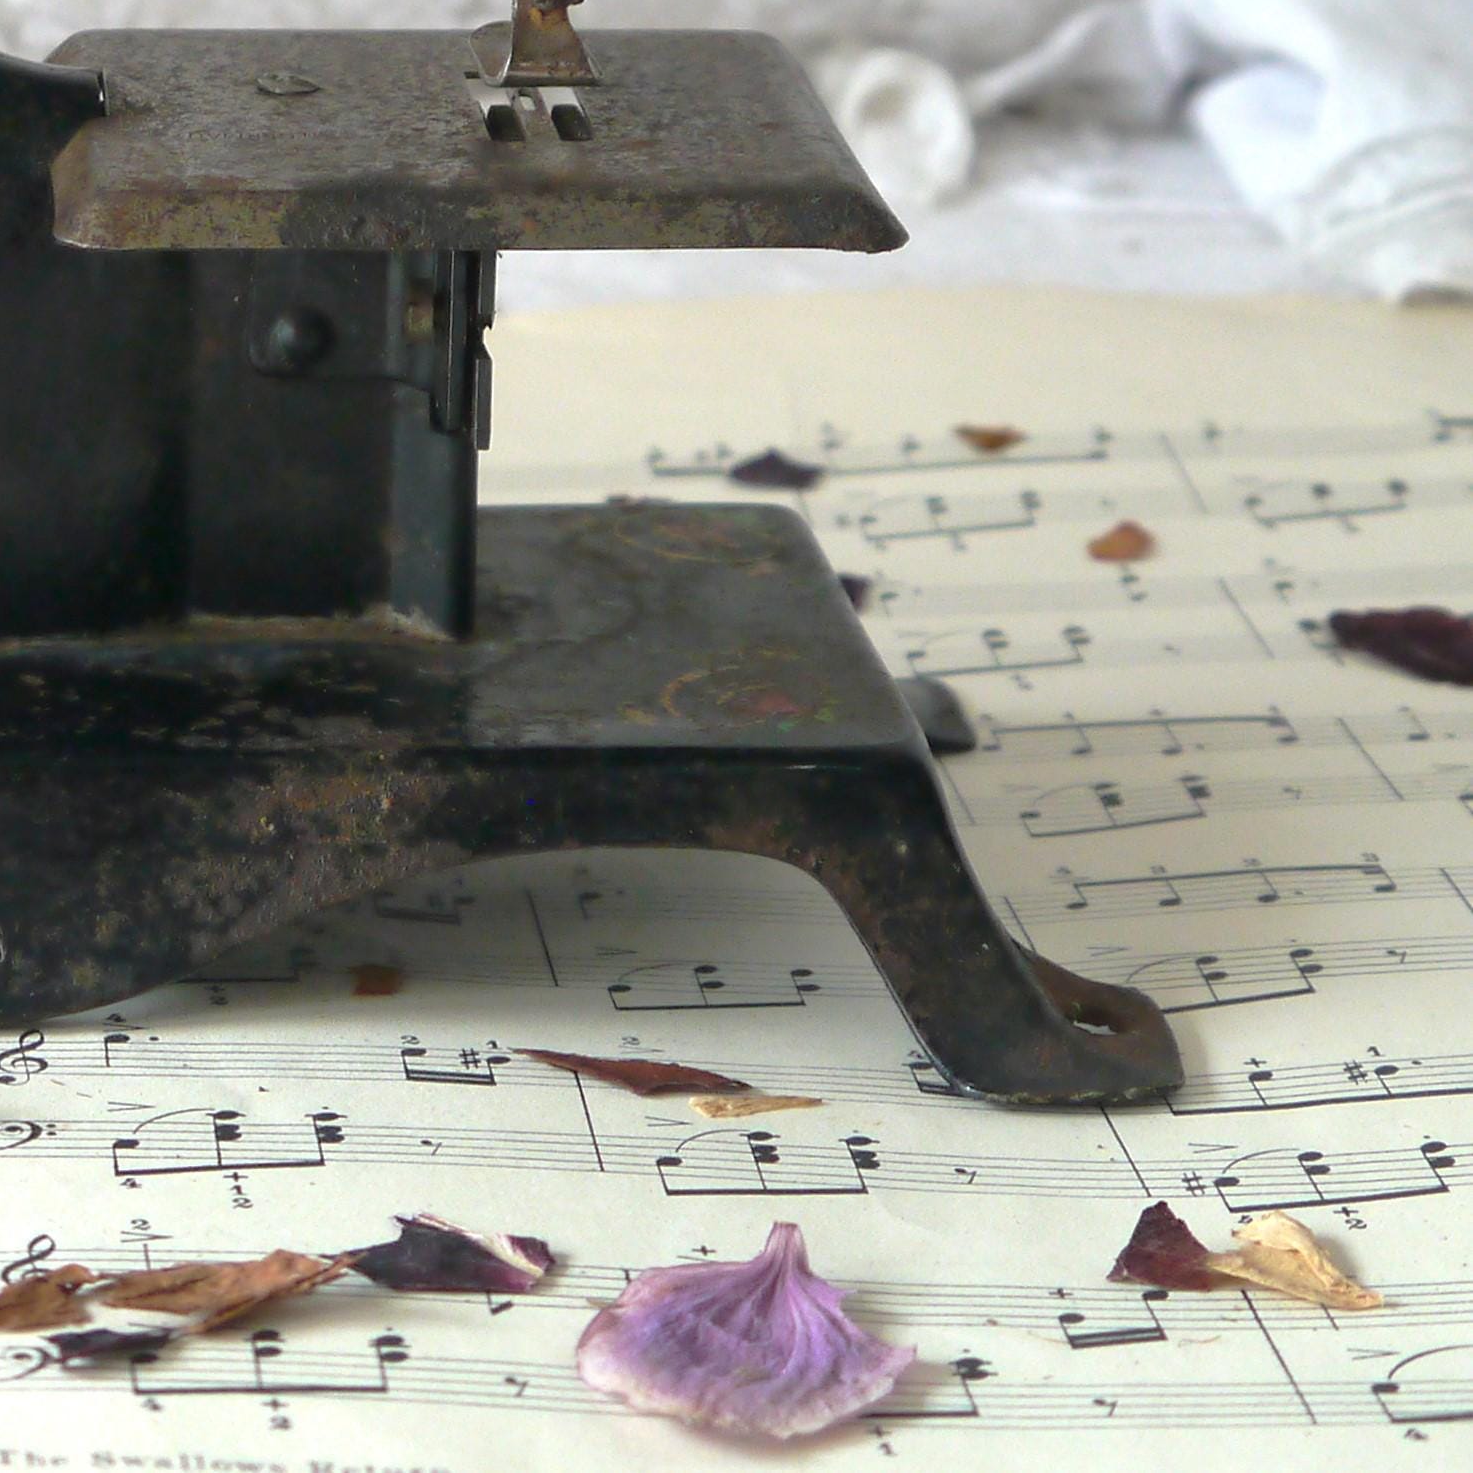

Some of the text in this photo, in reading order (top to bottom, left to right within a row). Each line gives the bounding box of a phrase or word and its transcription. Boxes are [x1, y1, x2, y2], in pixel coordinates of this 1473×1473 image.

[232, 1197, 254, 1209] 2
[130, 1218, 151, 1231] 2
[90, 1450, 288, 1473] Swallows
